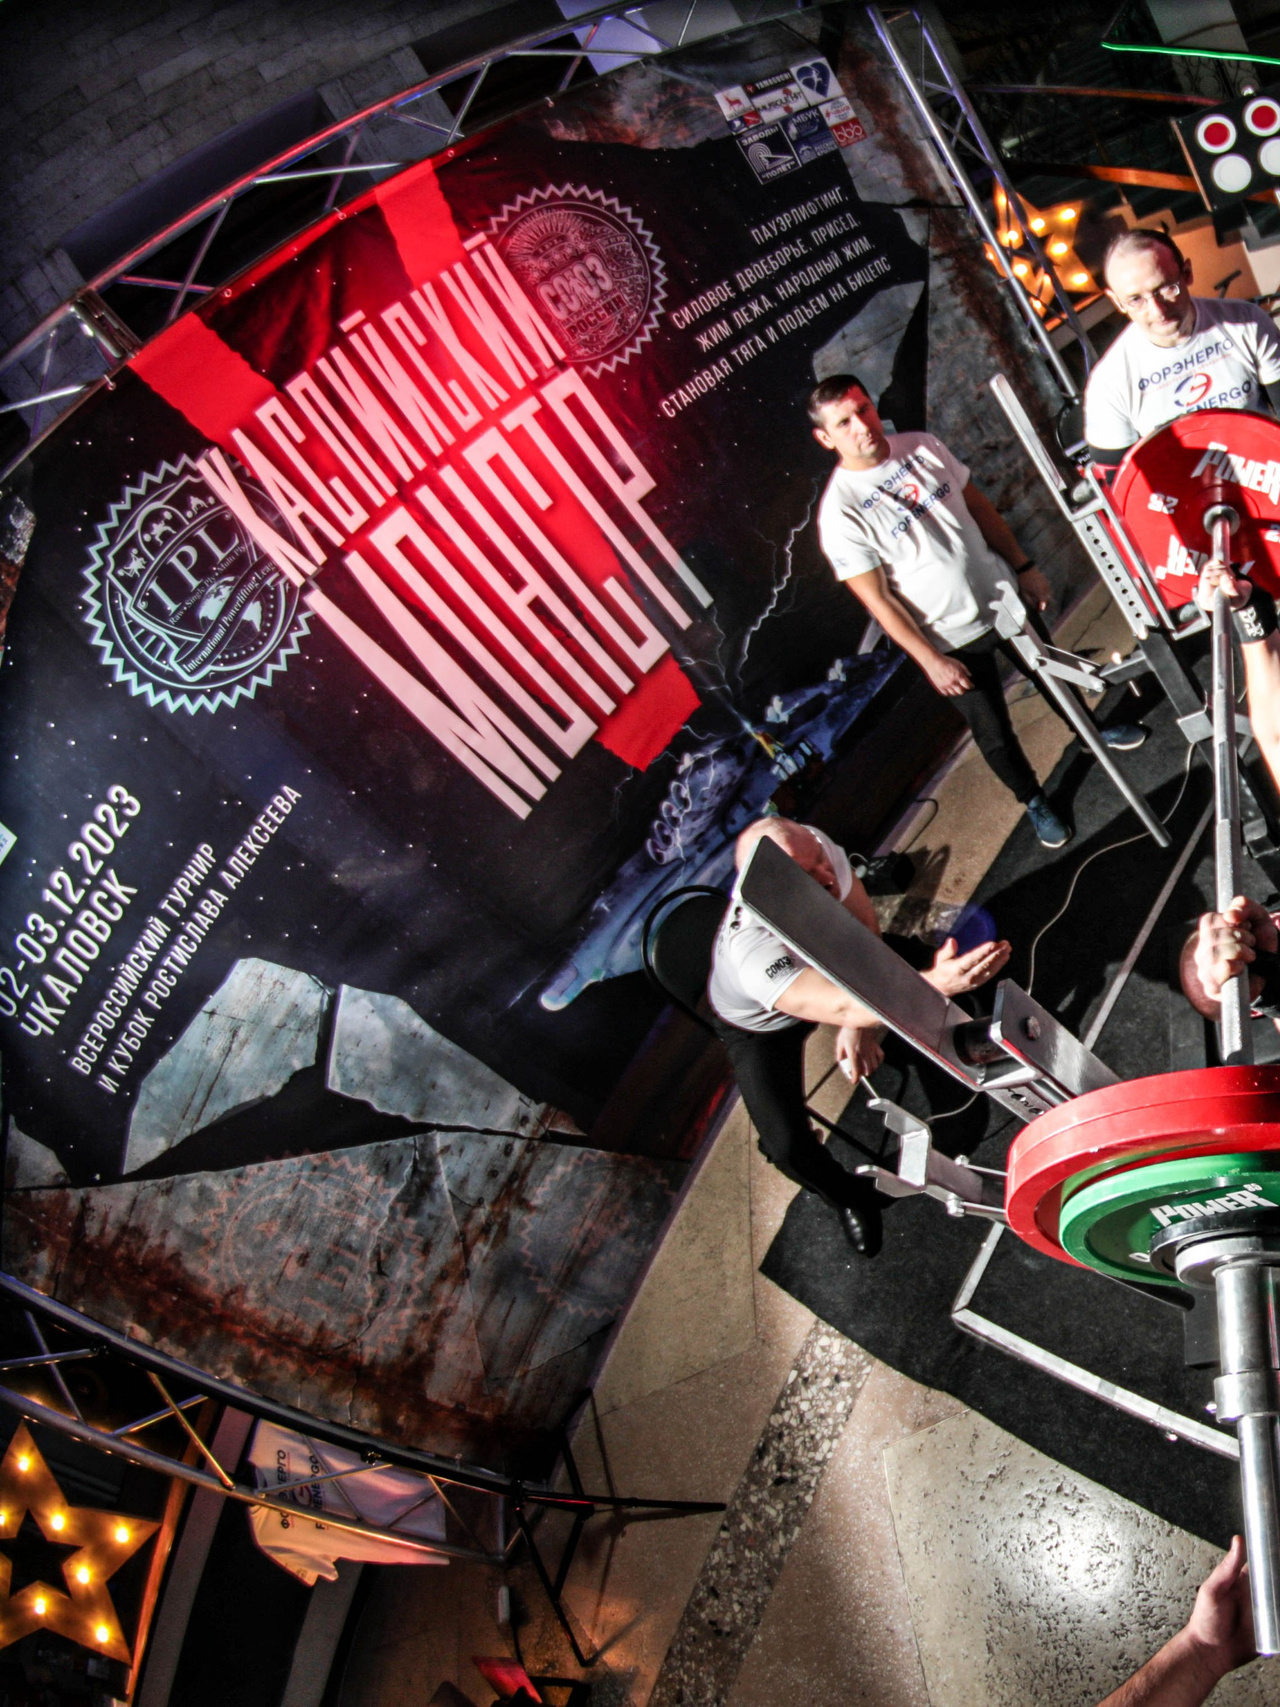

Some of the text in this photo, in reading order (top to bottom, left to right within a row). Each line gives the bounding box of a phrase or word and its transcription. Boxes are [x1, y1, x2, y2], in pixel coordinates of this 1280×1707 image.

[742, 126, 778, 146] ЗАВОДЫ
[792, 109, 820, 124] МБУК
[566, 294, 627, 340] РОССИИ
[661, 256, 892, 418] СТАНОВАЯ ТЯГА И ПОДЪЕМ НА БИЦЕПС
[672, 281, 736, 330] СИЛОВОЕ
[695, 318, 733, 353] ЖИМ
[775, 249, 843, 300] НАРОДНЫЙ
[197, 232, 566, 588] КАСПИЙСКИЙ
[1138, 338, 1234, 391] ФОРЭНЕРГО
[863, 455, 925, 510] ФОЭНЕРО
[147, 524, 240, 617] IPL
[182, 561, 278, 673] International Powerlifting Leag
[302, 367, 715, 821] МОНСТР
[20, 868, 138, 1037] ЧКАЛОВСК
[70, 843, 217, 1075] ВСЕРОССИЙСКИЙ ТУРНИР
[98, 784, 303, 1095] И КУБОК РОСТИСЛАВА АЛЕКСЕЕВА
[1150, 1190, 1280, 1228] POWER
